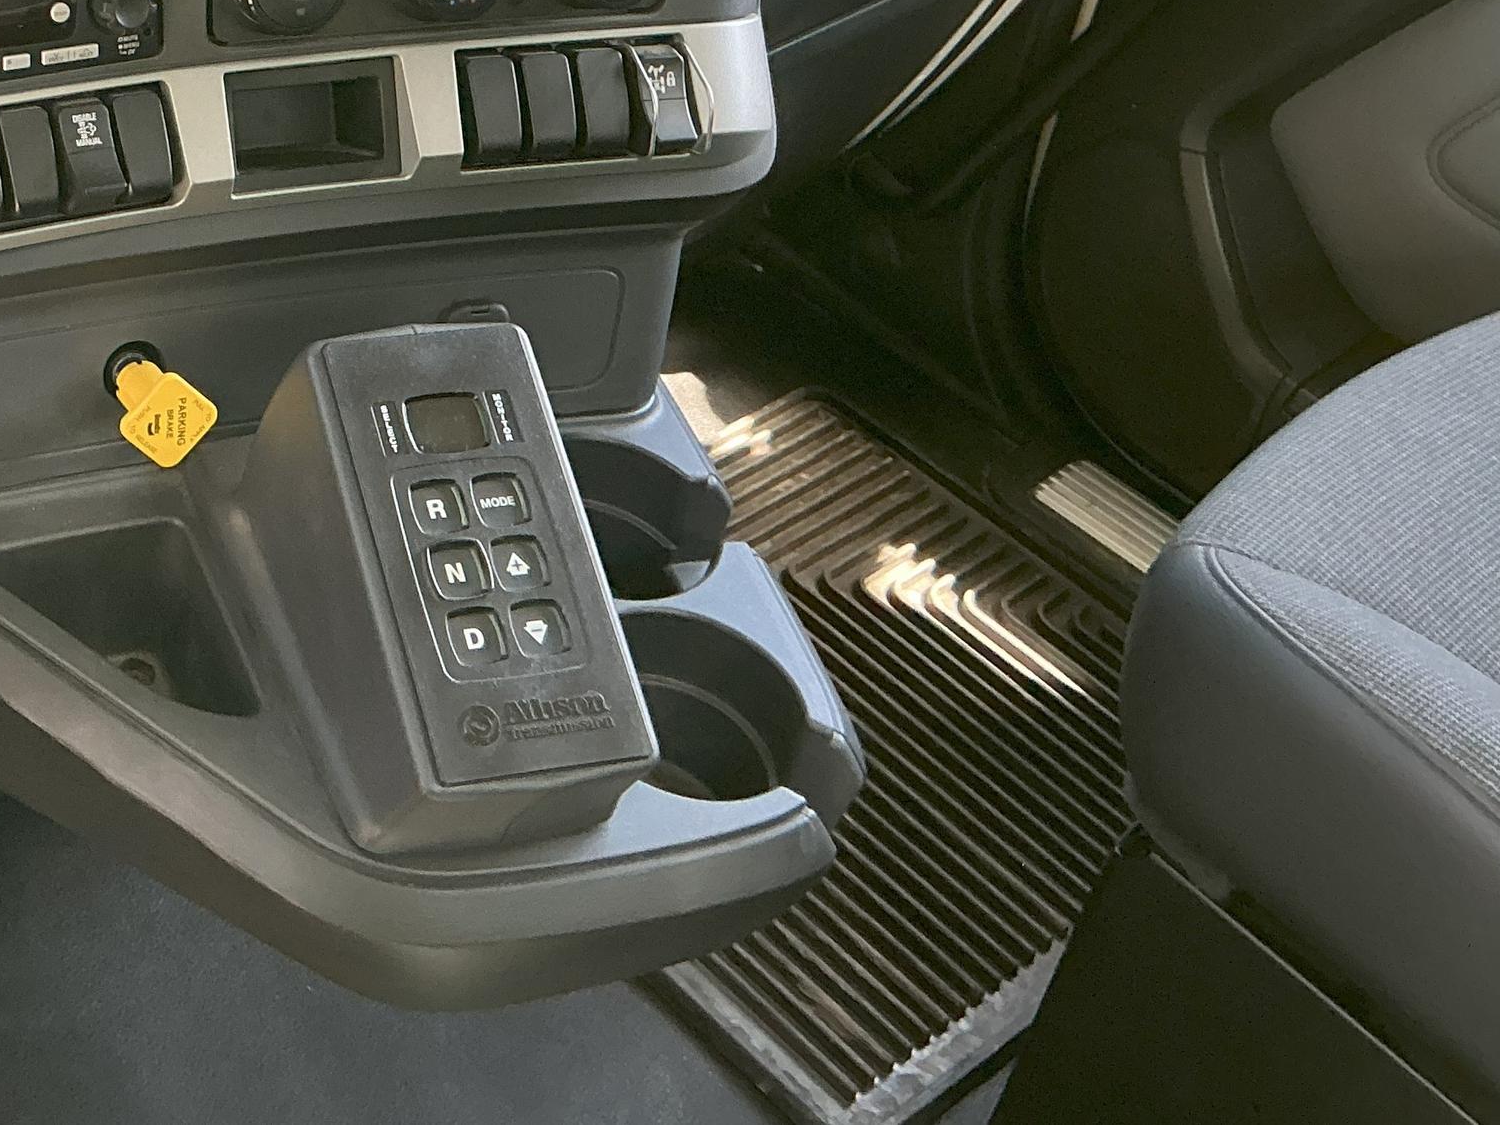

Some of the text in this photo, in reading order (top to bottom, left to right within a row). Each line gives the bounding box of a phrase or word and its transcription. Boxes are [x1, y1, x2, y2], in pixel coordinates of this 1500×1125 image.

[71, 112, 97, 123] DISABLE
[166, 409, 174, 438] BRAKE
[176, 397, 187, 446] PARKING
[491, 393, 514, 441] MONITOR
[380, 404, 398, 453] SELECT
[425, 498, 447, 520] R
[479, 495, 516, 509] MODE
[444, 562, 466, 584] N
[463, 628, 485, 650] D
